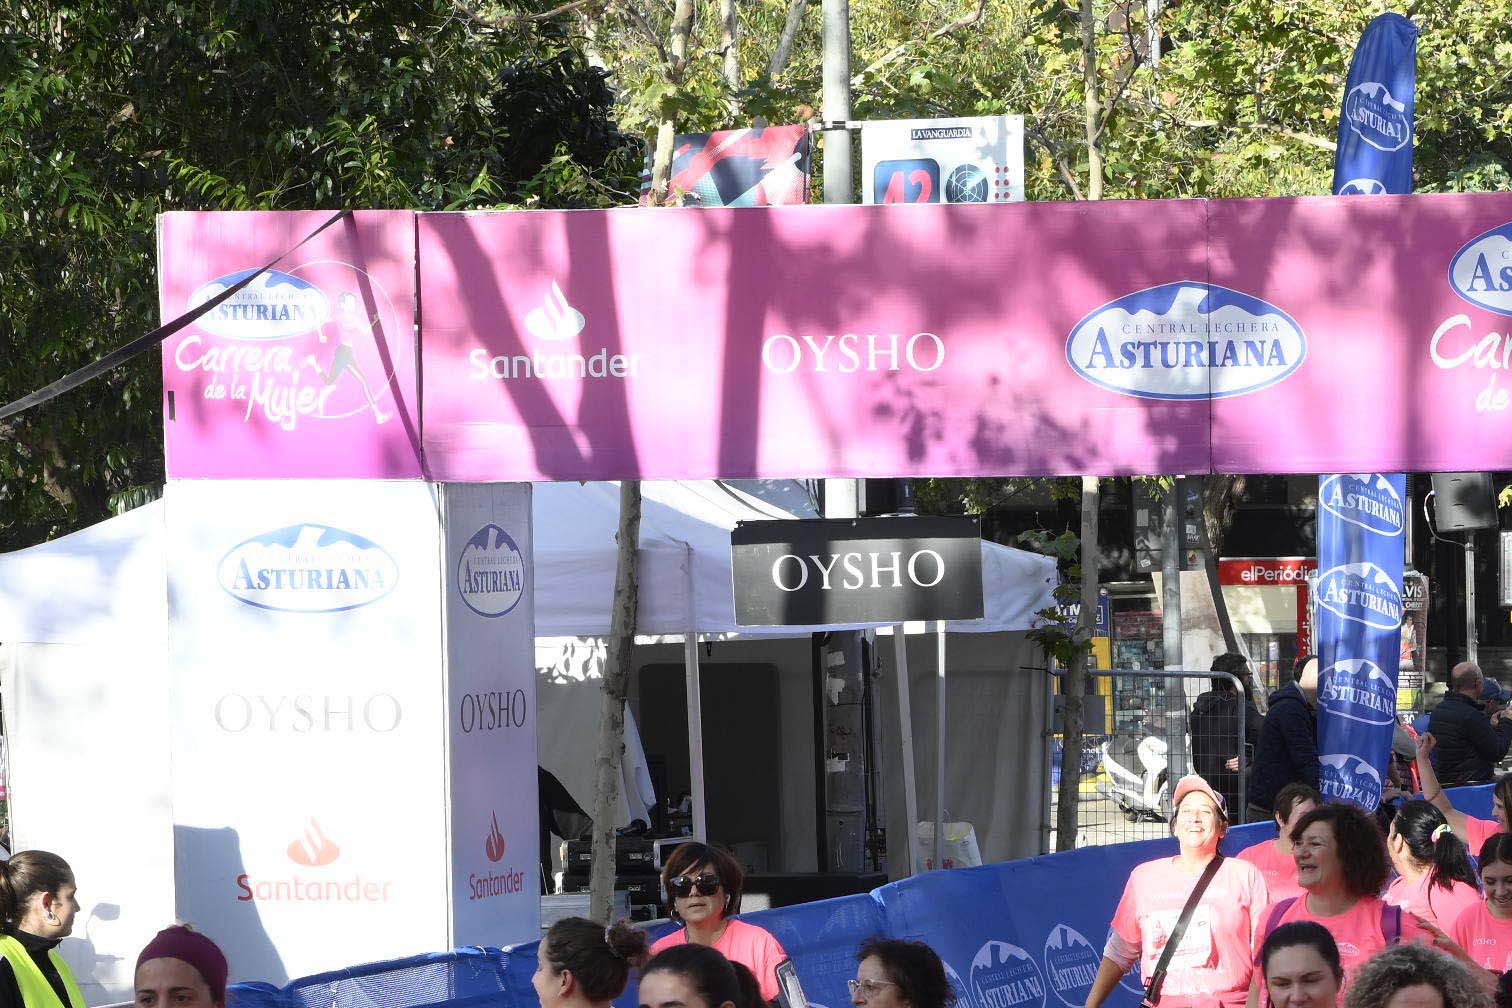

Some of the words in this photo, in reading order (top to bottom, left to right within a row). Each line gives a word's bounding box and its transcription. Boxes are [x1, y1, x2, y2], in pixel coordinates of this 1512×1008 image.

[922, 128, 971, 138] VANGUARDIA
[1086, 326, 1287, 369] ASTURIANA
[1122, 323, 1199, 335] CENTRAL
[1205, 320, 1280, 334] LECHERA
[175, 335, 292, 372] Carrera
[469, 348, 645, 380] Santander
[762, 332, 946, 374] OYSHO
[204, 378, 226, 400] de
[232, 381, 246, 400] la
[244, 371, 336, 432] Mujer
[1476, 374, 1509, 412] de
[1328, 483, 1401, 528] ASTURIANA
[233, 558, 385, 590] ASTURIANA
[463, 560, 520, 594] ASTURIANA
[772, 549, 946, 592] OYSHO
[1324, 576, 1400, 622] ASTURIANA
[214, 692, 402, 734] OYSHO
[460, 688, 526, 734] OYSHO
[1320, 676, 1394, 718] ASTURIANA
[237, 874, 392, 903] Santander
[469, 868, 524, 901] Santander
